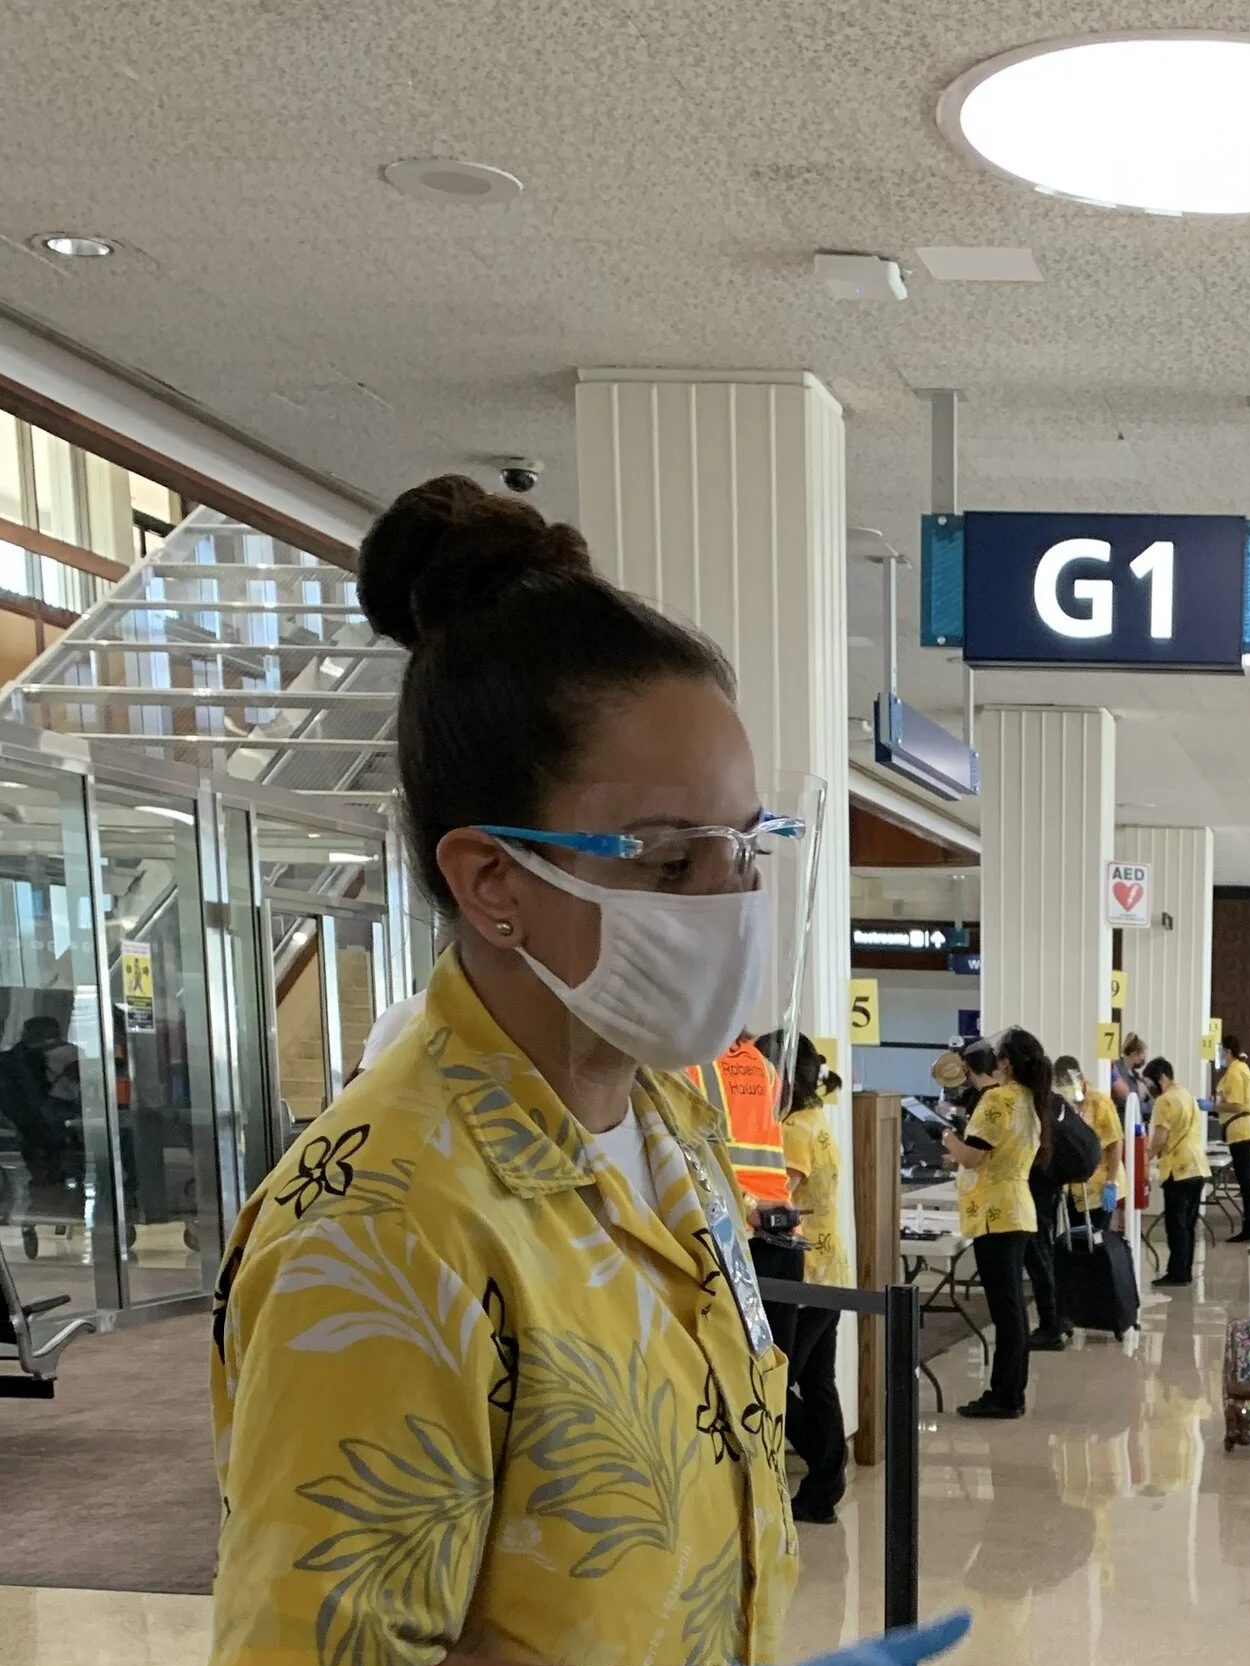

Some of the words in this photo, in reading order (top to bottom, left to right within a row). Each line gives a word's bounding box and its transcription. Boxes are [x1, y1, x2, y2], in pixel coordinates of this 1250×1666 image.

[1034, 538, 1174, 639] G1
[1112, 866, 1145, 881] AED
[852, 996, 871, 1028] 5
[1104, 1032, 1115, 1050] 7
